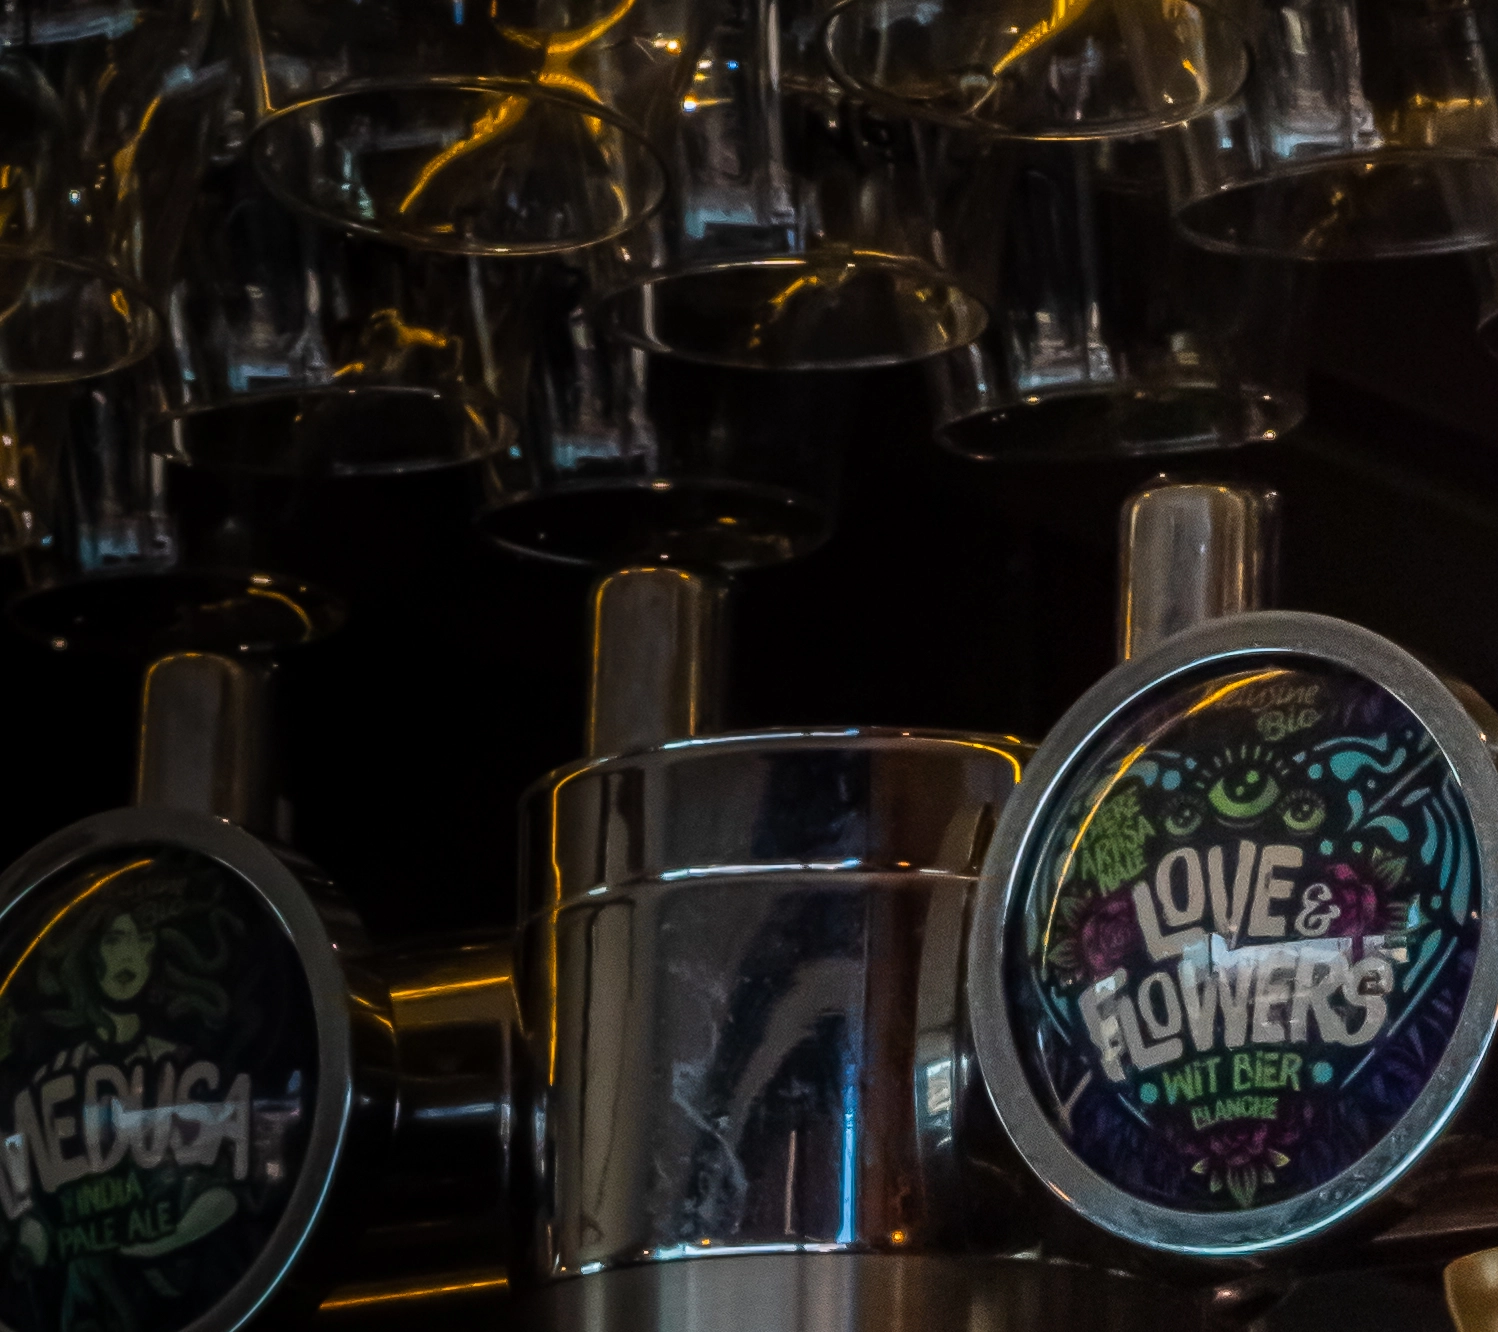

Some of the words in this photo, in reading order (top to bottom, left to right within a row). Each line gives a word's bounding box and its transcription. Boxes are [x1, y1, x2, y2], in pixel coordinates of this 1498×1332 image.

[1133, 838, 1304, 963] LOVE
[1295, 881, 1341, 937] &
[1078, 955, 1396, 1084] FLOWERS
[1161, 1060, 1221, 1099] WIT
[1232, 1052, 1304, 1092] BIER
[1192, 1096, 1280, 1131] BLANCHE
[58, 1216, 118, 1260] PALE
[128, 1201, 175, 1241] ALE
